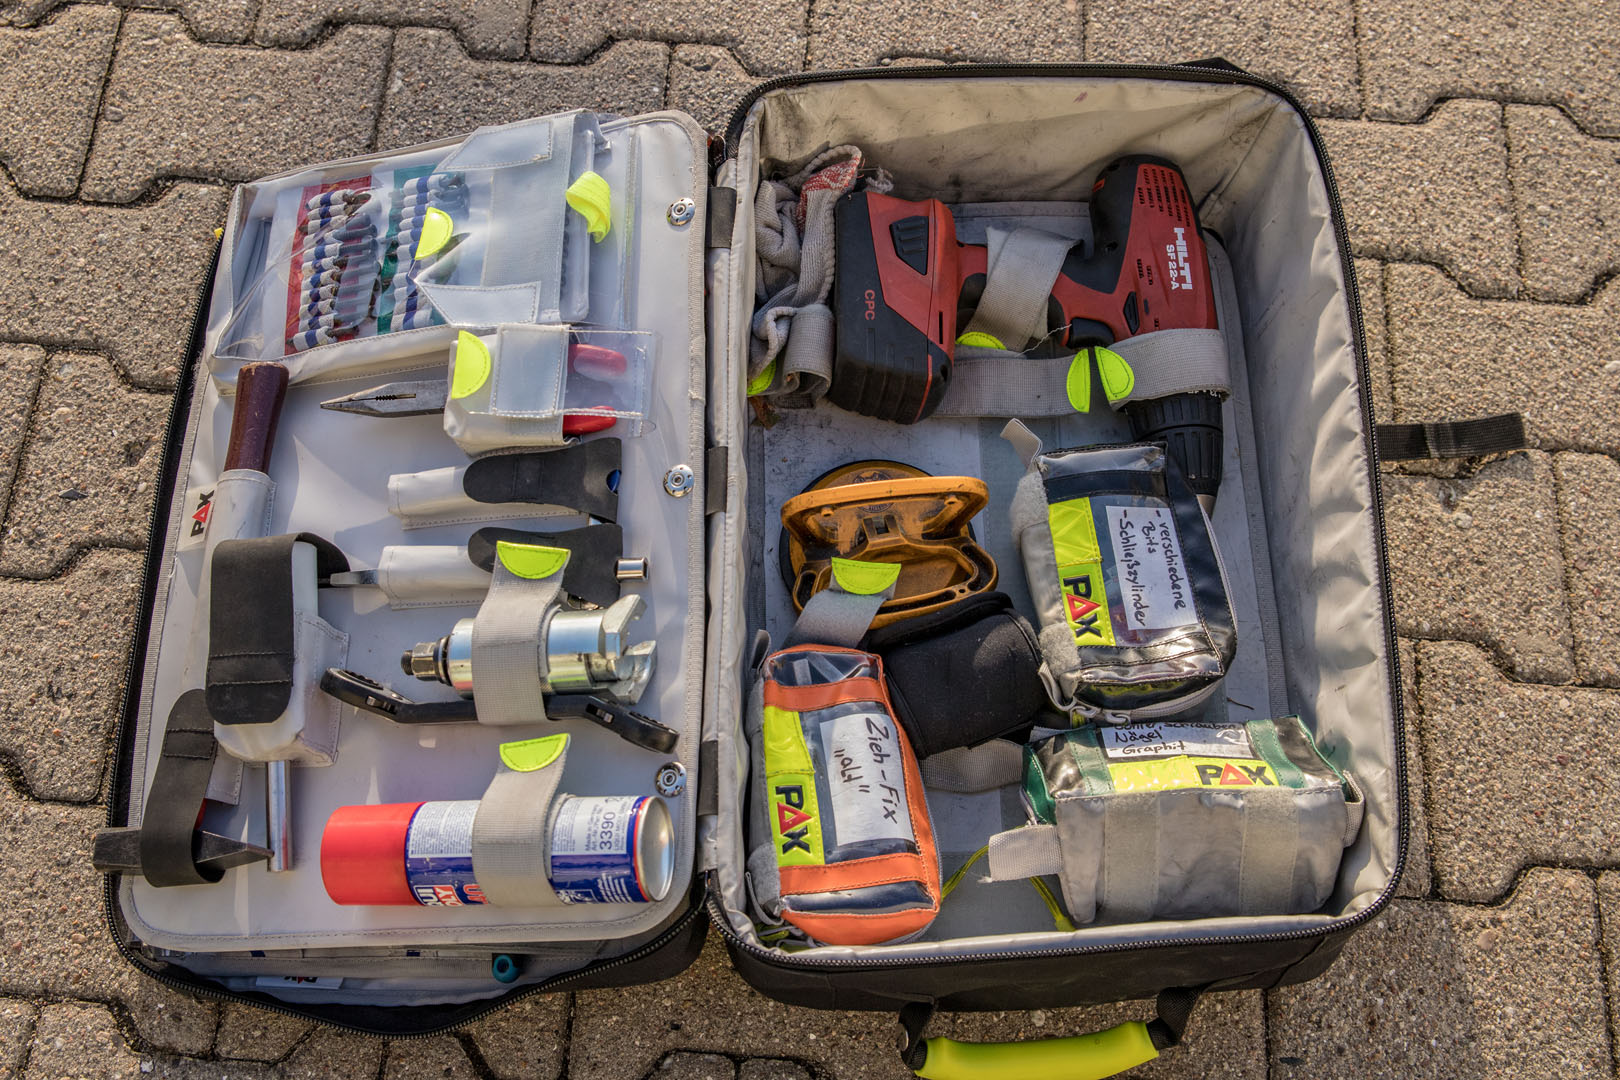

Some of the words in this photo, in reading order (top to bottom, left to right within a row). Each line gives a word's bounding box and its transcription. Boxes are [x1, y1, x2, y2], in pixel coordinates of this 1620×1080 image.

[1166, 244, 1176, 260] SF
[1174, 227, 1192, 290] HILTI
[1168, 261, 1179, 290] 22-A
[864, 289, 876, 320] CPC
[190, 490, 215, 537] PAX
[1141, 521, 1159, 554] Bits
[1159, 521, 1186, 610] verschiedene
[1063, 574, 1102, 638] PAX
[1115, 729, 1163, 743] Nägel
[1122, 740, 1186, 755] Graphit
[1195, 763, 1275, 785] PAX
[599, 811, 616, 850] 3390
[775, 785, 812, 855] PAX
